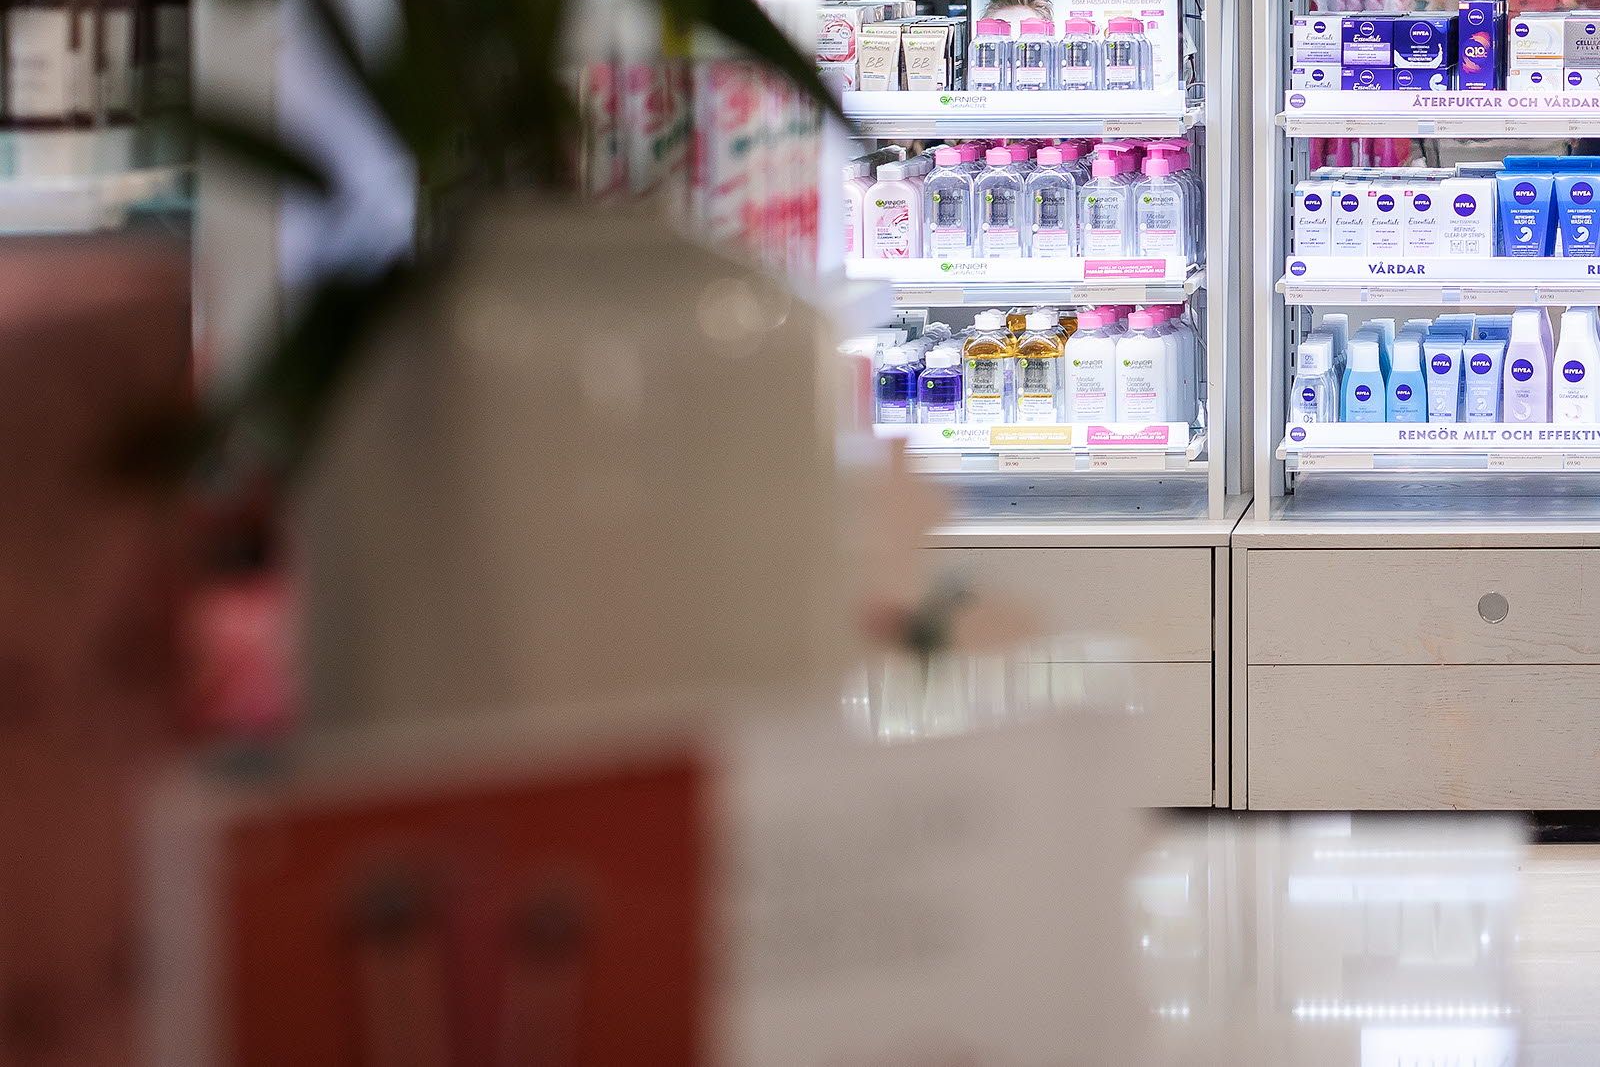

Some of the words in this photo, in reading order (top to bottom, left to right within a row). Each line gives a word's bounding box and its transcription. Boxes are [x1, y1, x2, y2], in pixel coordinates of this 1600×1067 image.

[1465, 46, 1485, 55] Q10
[866, 57, 884, 68] BB
[912, 57, 930, 69] BB
[940, 95, 987, 105] GARNIER
[1413, 94, 1502, 107] ÅTERFUKTAR
[1508, 97, 1538, 107] OCH
[1544, 95, 1600, 107] VÅRDAR
[1299, 217, 1327, 226] Essentials
[1335, 217, 1364, 226] Essentials
[1372, 218, 1399, 226] Essentials
[941, 262, 988, 272] GARNIER
[1368, 261, 1425, 274] VÅRDAR
[942, 428, 990, 439] GARNIER
[1399, 426, 1458, 440] RENGÖR
[1463, 430, 1496, 440] MILT
[1501, 430, 1532, 440] OCH
